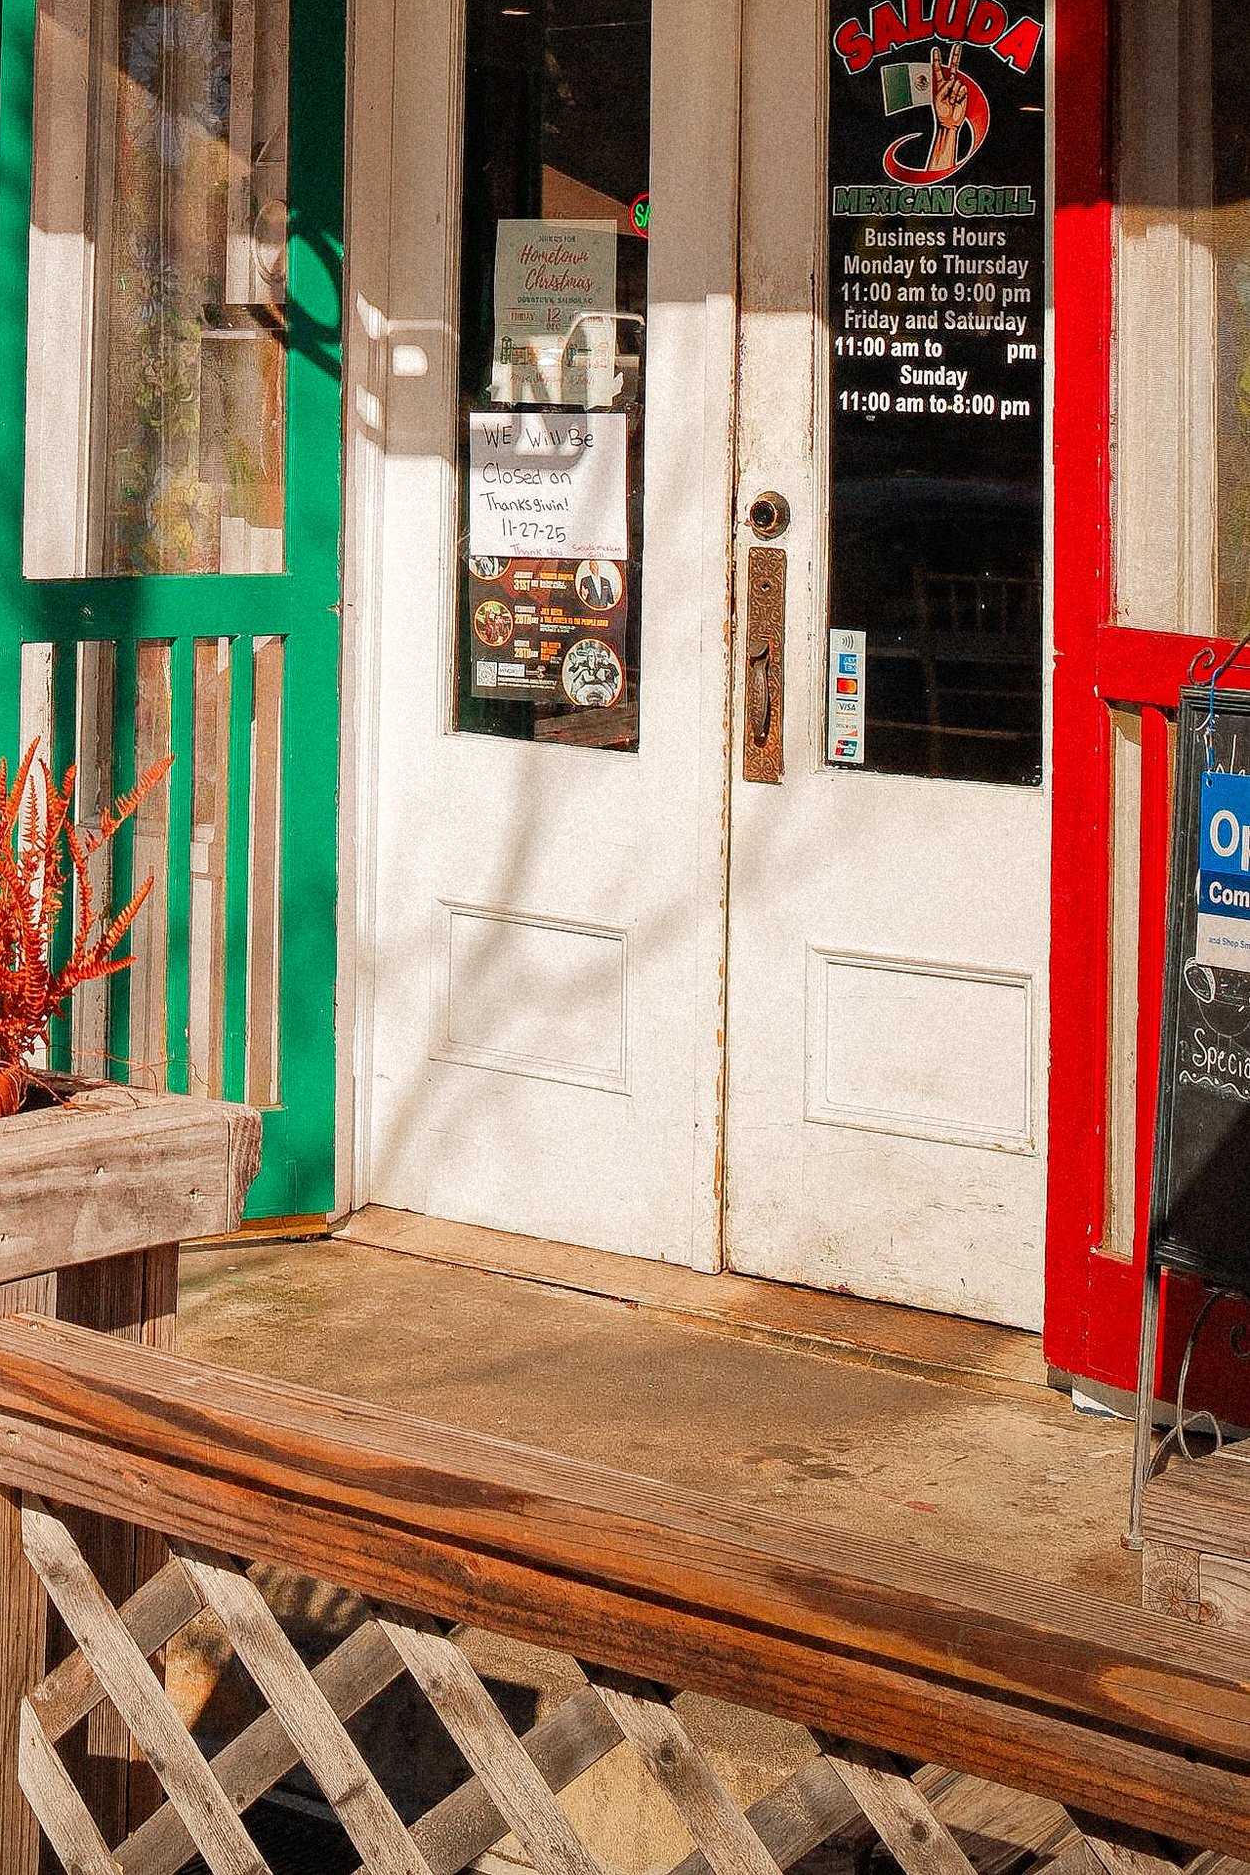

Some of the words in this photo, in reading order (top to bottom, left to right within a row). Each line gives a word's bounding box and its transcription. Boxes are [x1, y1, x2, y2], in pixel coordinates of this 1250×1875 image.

[833, 186, 955, 217] MEXICAN
[954, 185, 1036, 217] GRILL
[864, 227, 946, 246] Business
[952, 227, 1007, 246] Hours
[525, 263, 594, 293] Christmas
[844, 256, 915, 279] Monday
[920, 256, 937, 274] to
[943, 255, 1029, 280] Thursday
[841, 282, 892, 302] 11:00
[897, 290, 925, 302] am
[930, 284, 948, 302] to
[954, 283, 996, 303] 9:00
[1002, 290, 1031, 307] pm
[845, 309, 899, 335] Friday
[905, 311, 938, 329] and
[944, 311, 1027, 336] Saturday
[835, 336, 885, 357] 11:00
[891, 342, 919, 357] am
[924, 338, 943, 357] to
[1007, 343, 1037, 364] pm
[900, 365, 968, 391] Sunday
[839, 390, 891, 412] 11:00
[895, 397, 924, 413] am
[929, 394, 946, 413] to
[952, 394, 995, 415] 8:00
[1000, 399, 1030, 420] pm
[483, 423, 512, 448] WE
[568, 428, 594, 447] Be
[550, 472, 572, 484] on
[502, 518, 567, 543] 11-27-25
[839, 703, 856, 711] VISA
